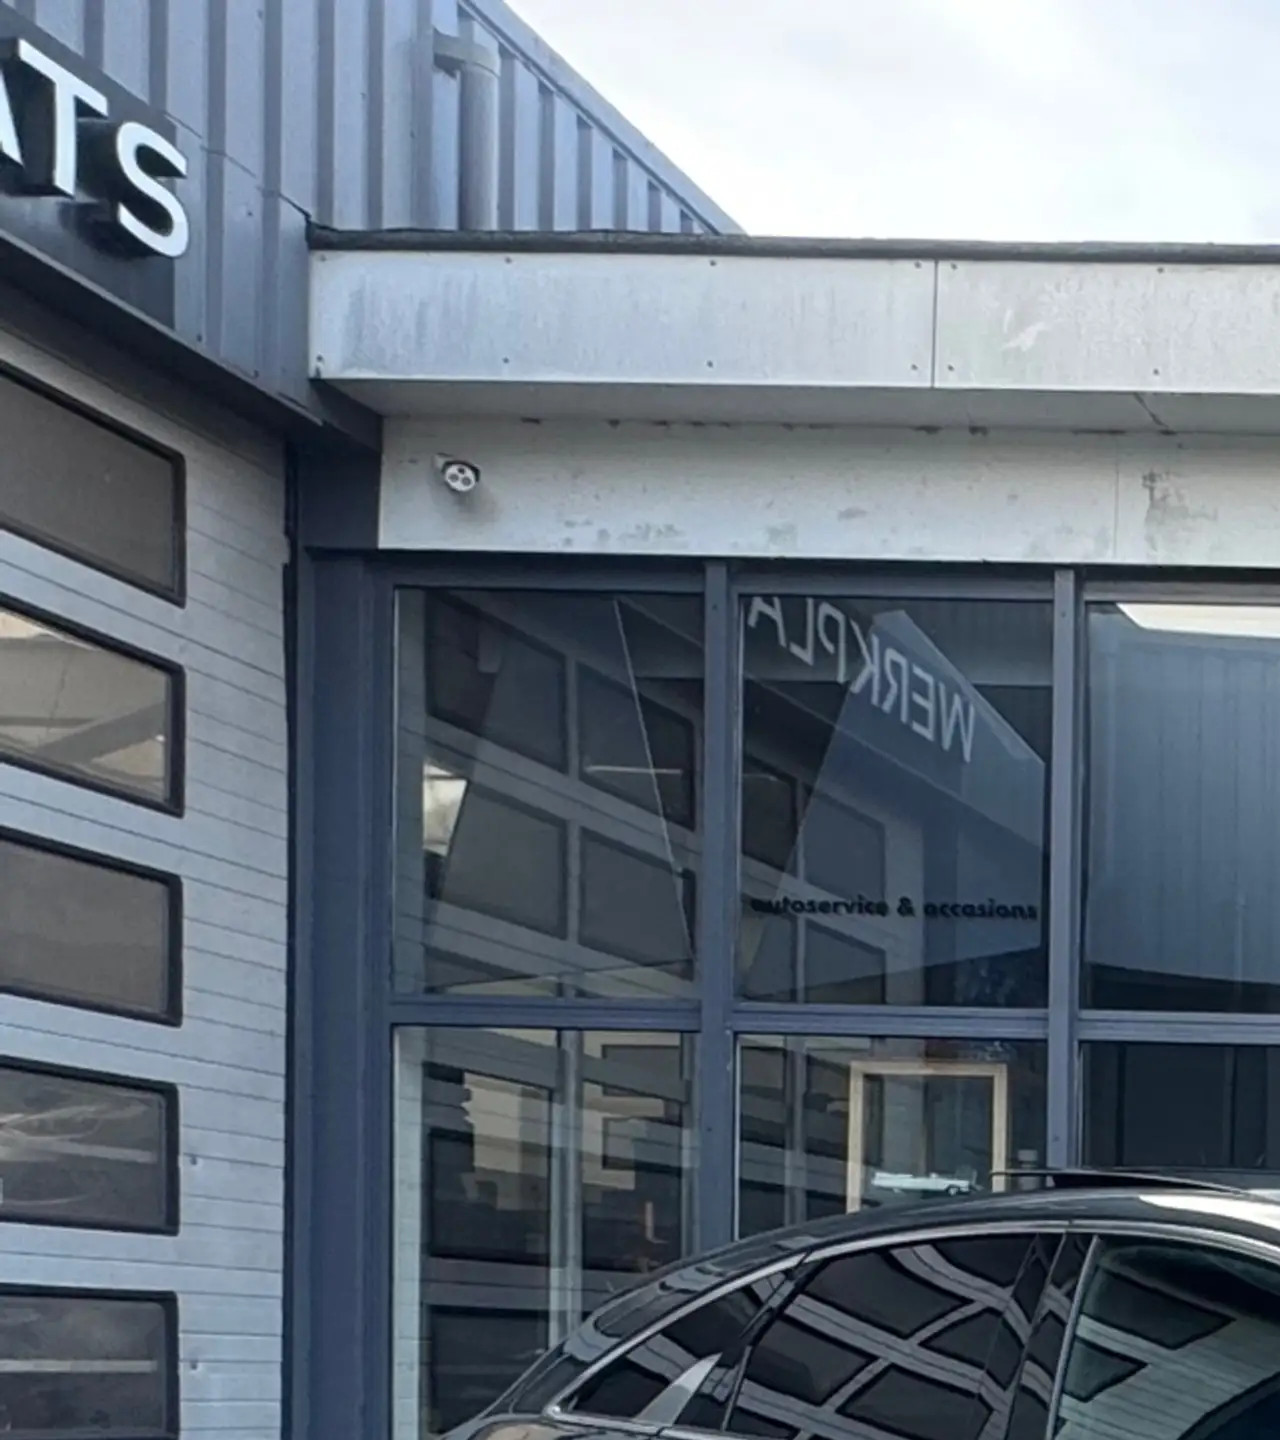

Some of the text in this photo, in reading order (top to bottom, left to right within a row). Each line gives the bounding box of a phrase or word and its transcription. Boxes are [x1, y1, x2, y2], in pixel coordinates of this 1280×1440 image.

[0, 38, 189, 257] TS
[750, 894, 1038, 921] autoservice & occasions
